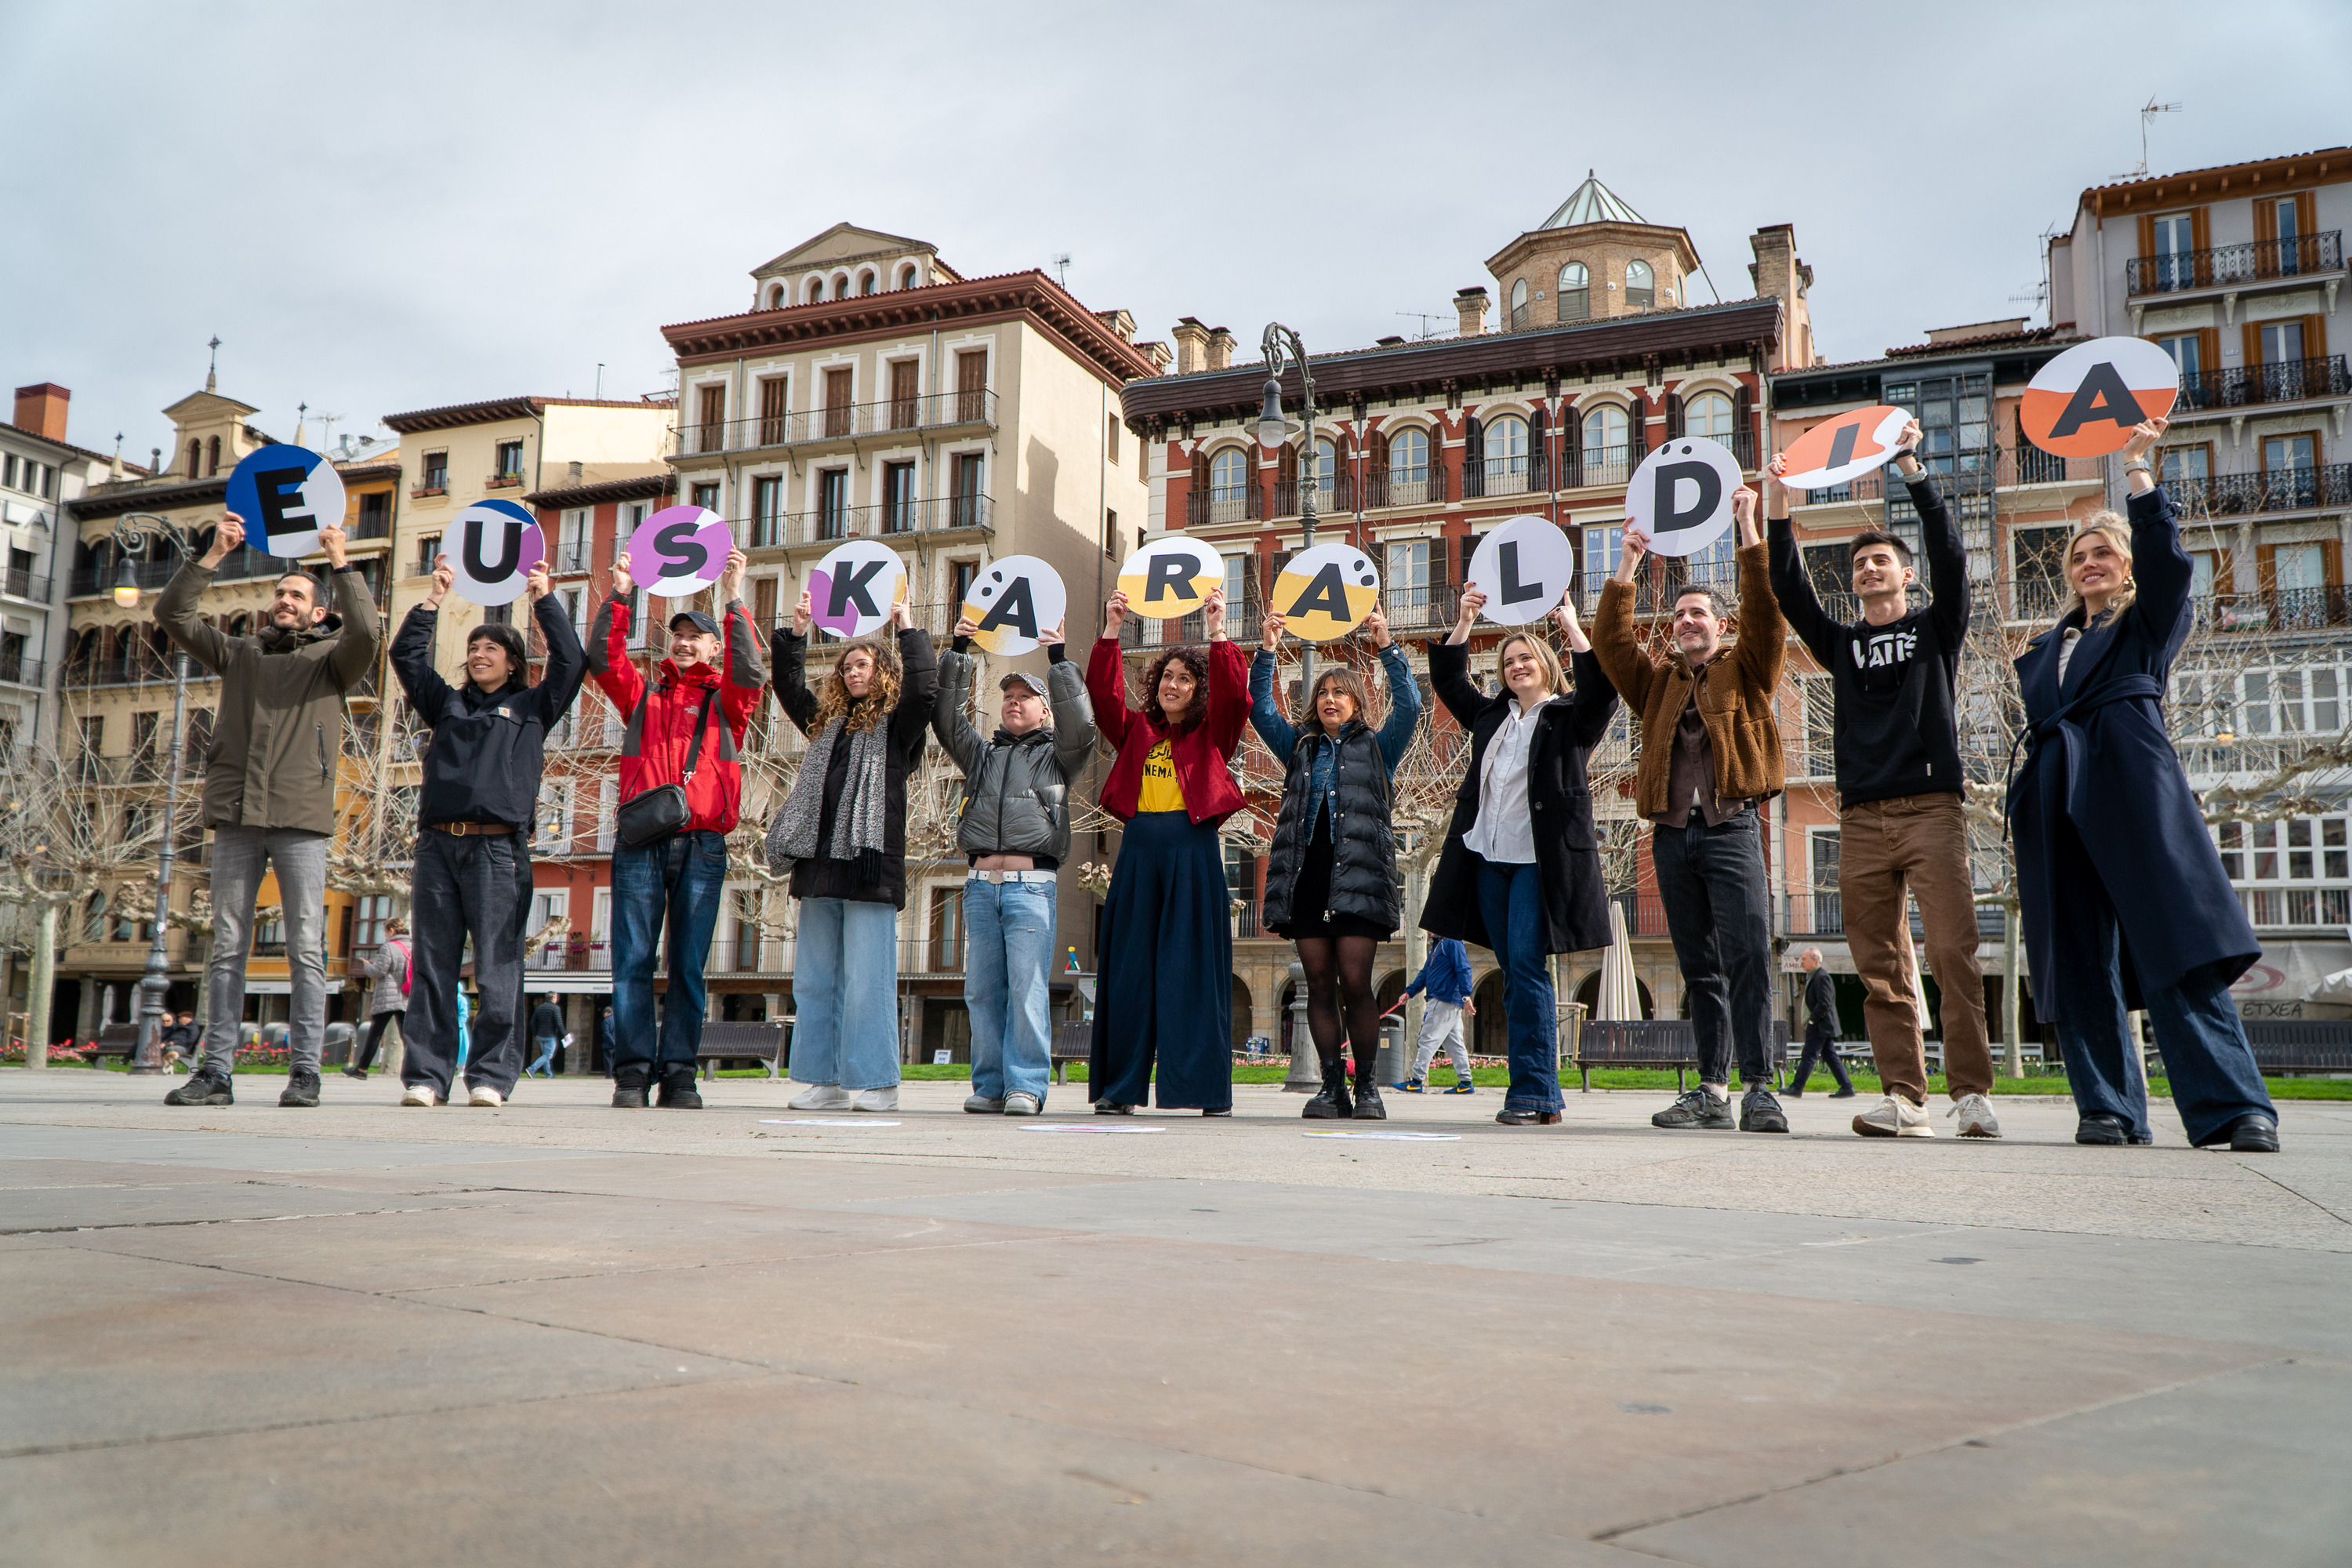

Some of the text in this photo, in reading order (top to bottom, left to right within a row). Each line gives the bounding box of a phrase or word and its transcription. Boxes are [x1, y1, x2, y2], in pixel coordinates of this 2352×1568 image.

[2048, 361, 2147, 439] A
[1825, 423, 1860, 470] I
[253, 466, 318, 538] E
[1653, 461, 1722, 534] D
[463, 521, 523, 584] U
[653, 522, 708, 578] S
[1144, 554, 1201, 601] R
[1498, 540, 1544, 606] L
[826, 561, 887, 617] K
[977, 576, 1039, 639] A
[1285, 562, 1352, 622] A
[2242, 1003, 2303, 1018] ETXEA
